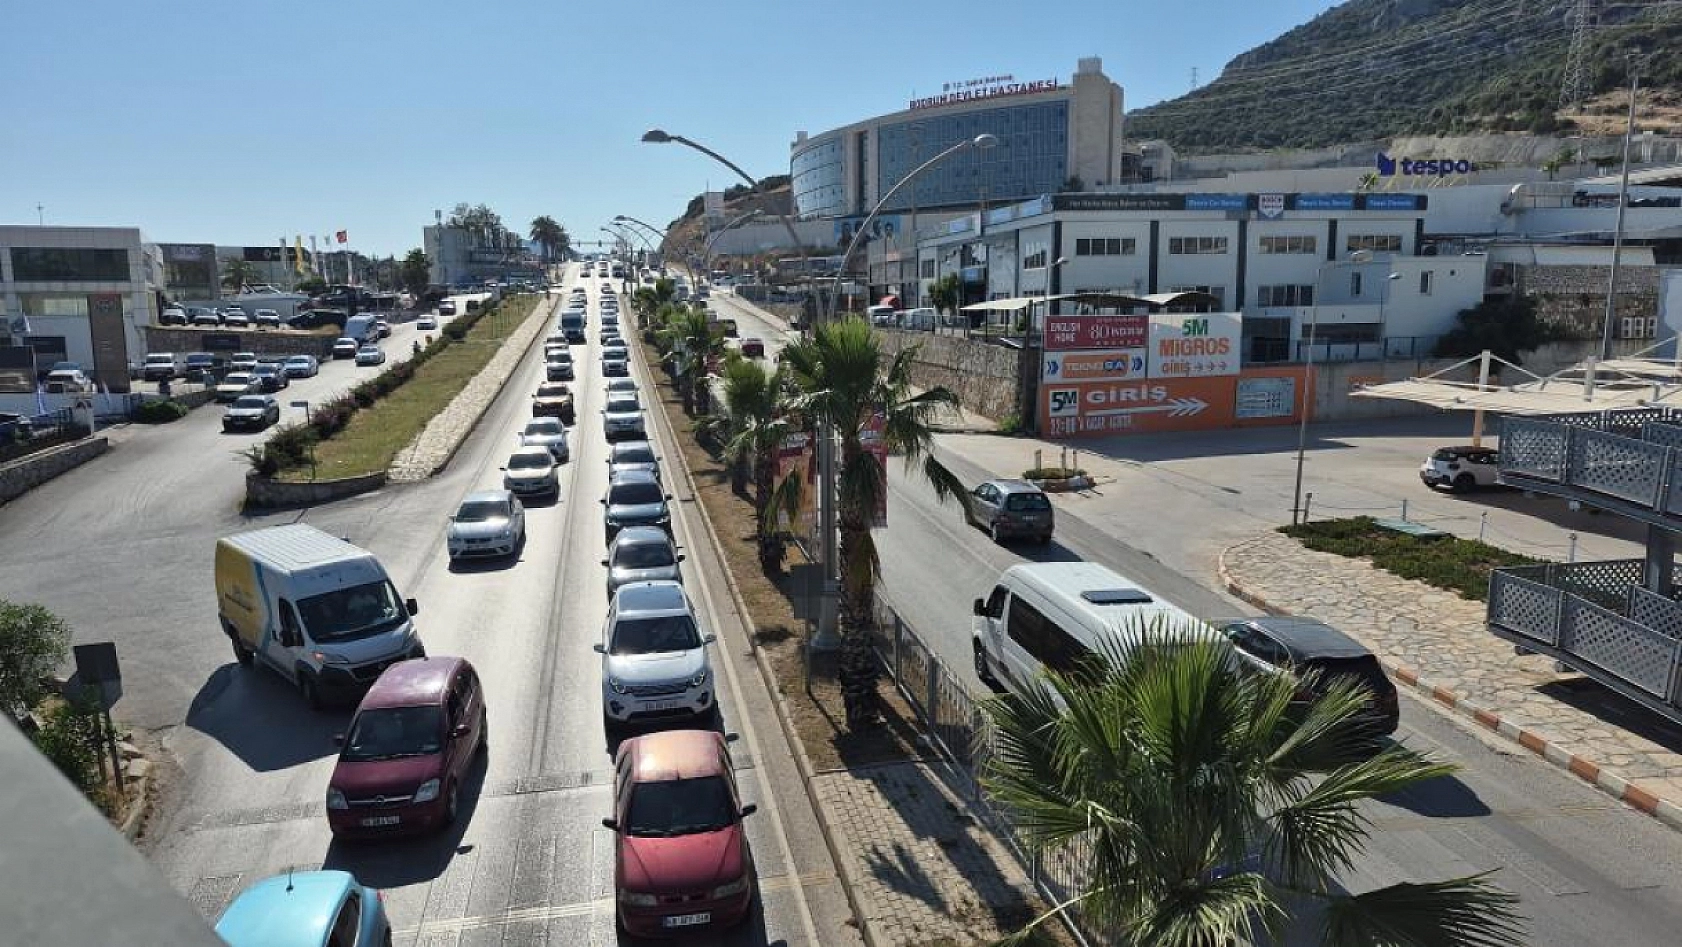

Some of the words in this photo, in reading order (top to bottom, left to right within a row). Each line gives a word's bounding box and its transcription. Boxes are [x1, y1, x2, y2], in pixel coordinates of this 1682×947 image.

[949, 86, 987, 104] DEVLET
[1400, 156, 1469, 177] tespo
[1050, 322, 1080, 332] ENGLISH
[1182, 319, 1209, 335] 5M
[1051, 390, 1077, 412] 5M
[1085, 385, 1168, 404] GİRİŞ
